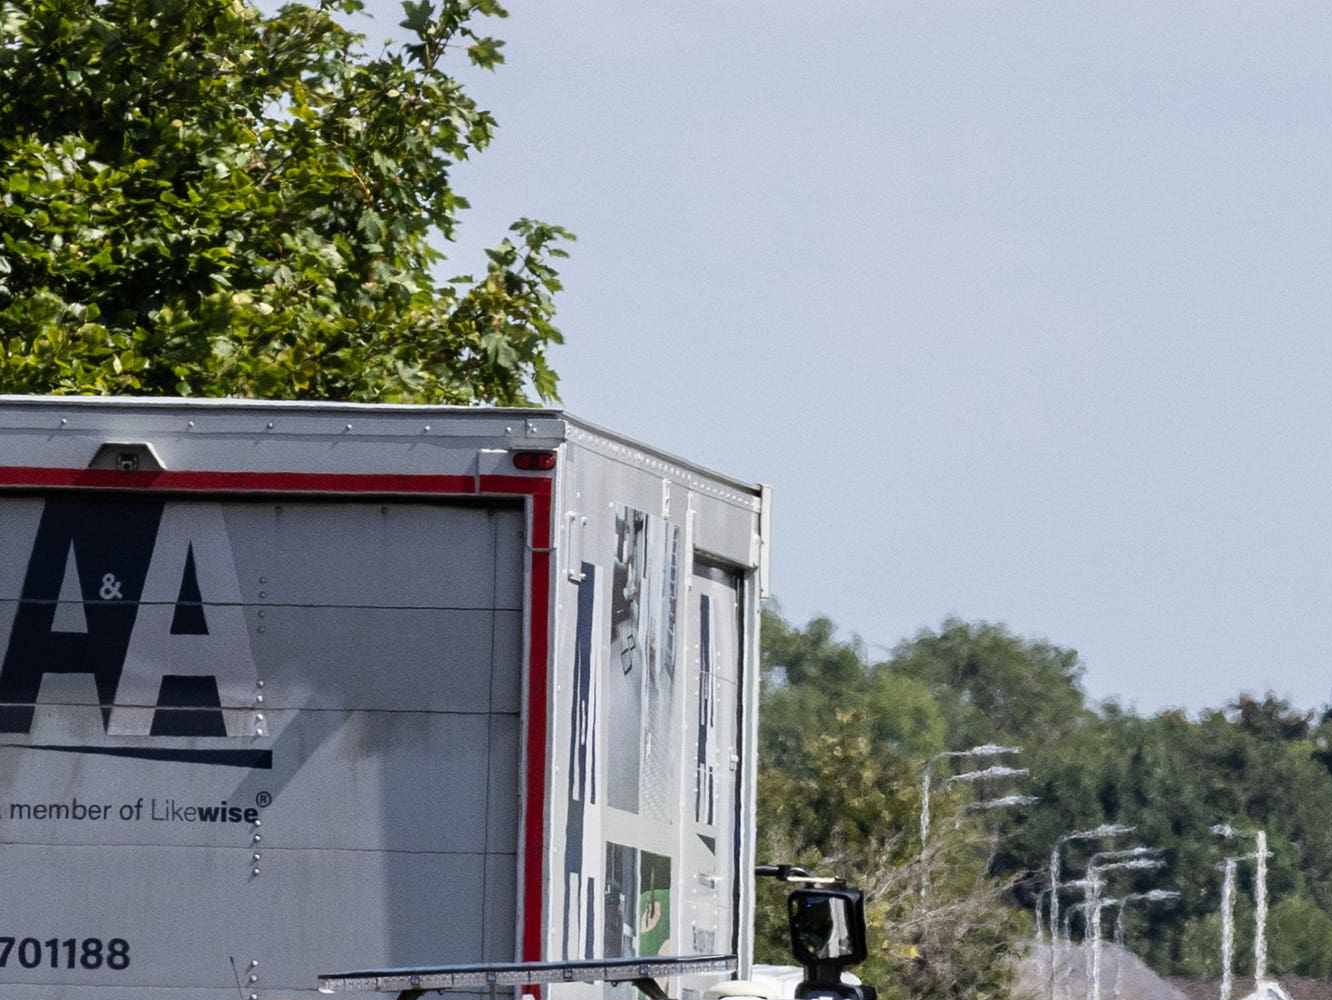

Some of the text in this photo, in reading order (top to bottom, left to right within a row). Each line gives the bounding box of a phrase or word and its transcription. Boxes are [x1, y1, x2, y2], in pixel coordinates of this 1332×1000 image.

[10, 798, 112, 821] member
[119, 798, 144, 821] of
[0, 937, 130, 970] 701188
